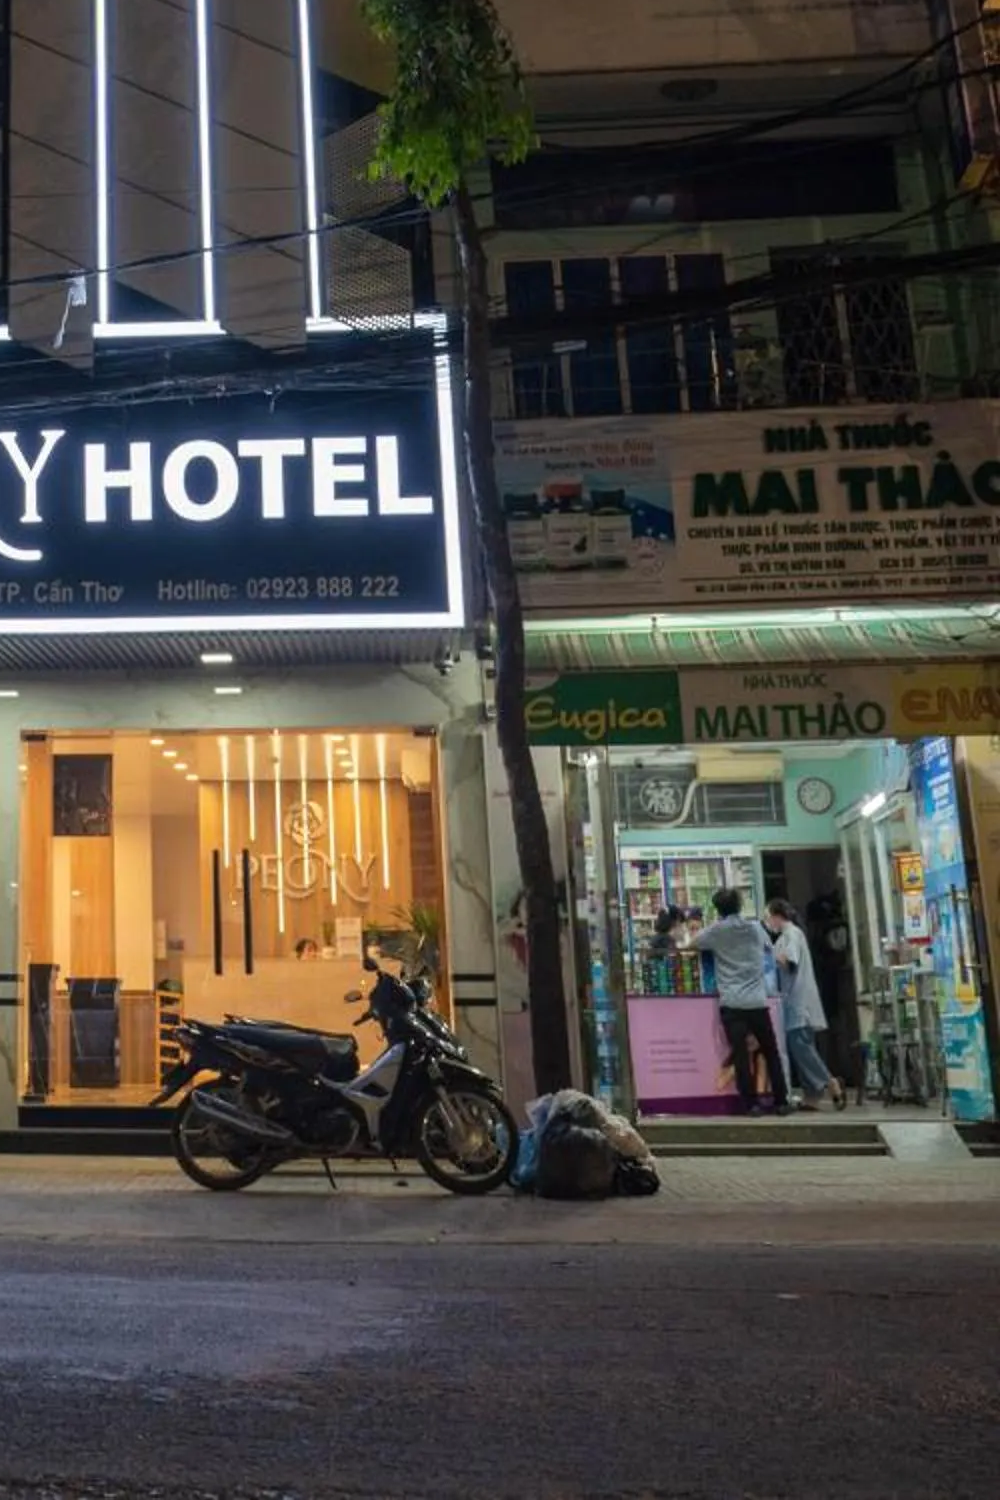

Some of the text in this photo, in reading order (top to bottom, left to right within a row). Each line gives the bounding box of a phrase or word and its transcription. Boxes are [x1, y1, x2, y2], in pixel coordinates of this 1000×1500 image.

[764, 414, 934, 454] NHÀ THUỐC
[84, 436, 434, 522] HOTEL
[693, 467, 820, 519] MAI
[80, 580, 125, 603] Thơ
[157, 578, 237, 601] Hotline:
[246, 576, 309, 599] 02923
[316, 575, 353, 598] 888
[361, 575, 400, 597] 222
[742, 671, 828, 690] NHÀ THUỐC
[523, 695, 667, 741] Eugica
[694, 690, 887, 740] MAI THẢO
[900, 686, 1000, 723] ENA
[234, 849, 376, 903] PEONY
